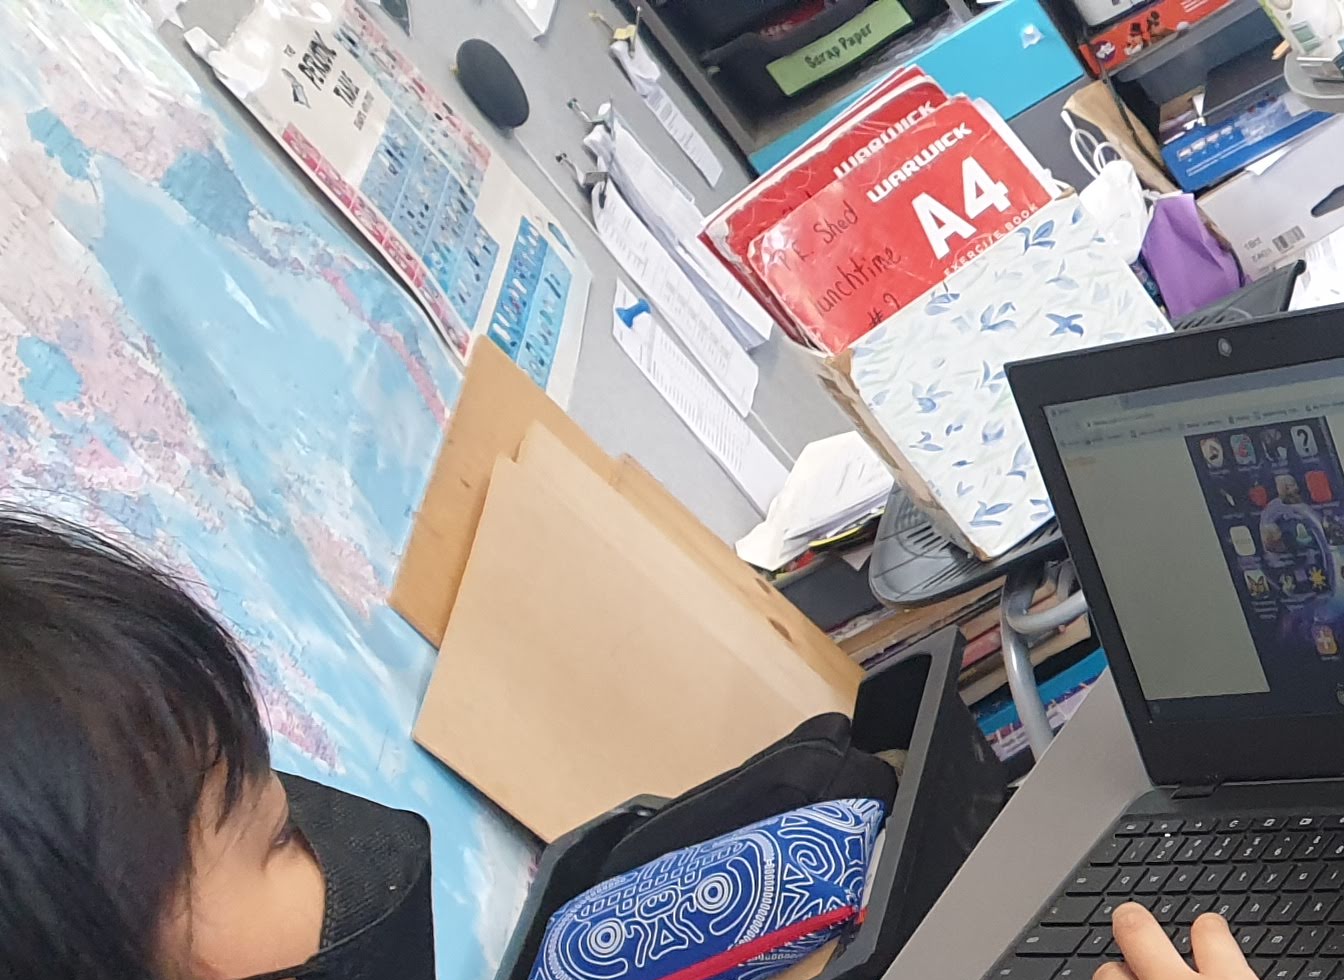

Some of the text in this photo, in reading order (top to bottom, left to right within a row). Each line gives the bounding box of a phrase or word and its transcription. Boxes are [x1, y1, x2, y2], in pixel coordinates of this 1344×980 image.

[804, 23, 872, 69] Scrap Paper
[832, 100, 938, 180] WARWICK
[866, 122, 973, 203] WARWICK
[813, 199, 858, 245] Shed
[911, 155, 1012, 260] A4
[1004, 203, 1038, 236] BOOK
